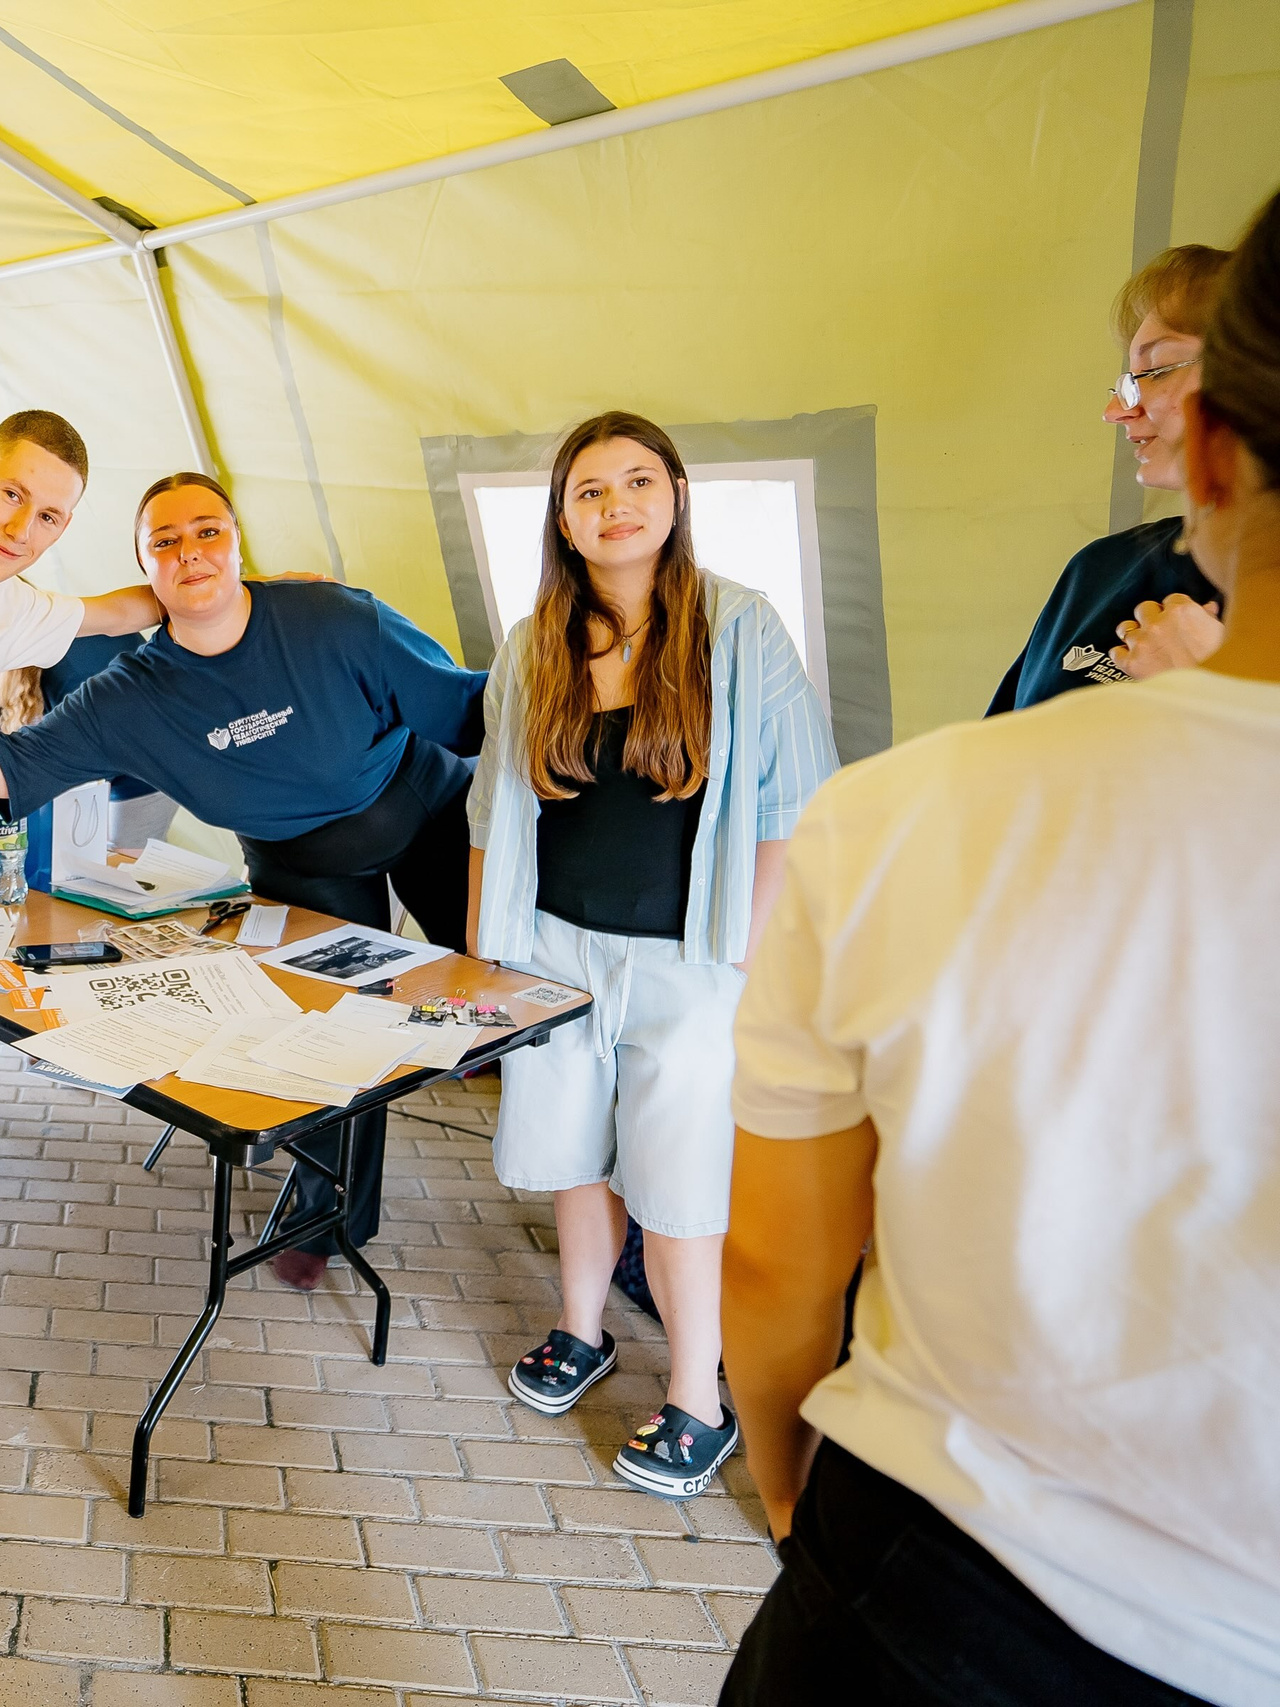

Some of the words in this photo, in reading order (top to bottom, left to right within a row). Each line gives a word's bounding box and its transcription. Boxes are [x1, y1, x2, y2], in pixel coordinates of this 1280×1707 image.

[228, 709, 269, 729] СУРГУТСКИЙ
[230, 705, 294, 735] ГОСУДАРСТВЕННЫЙ
[683, 1460, 720, 1494] crocs
